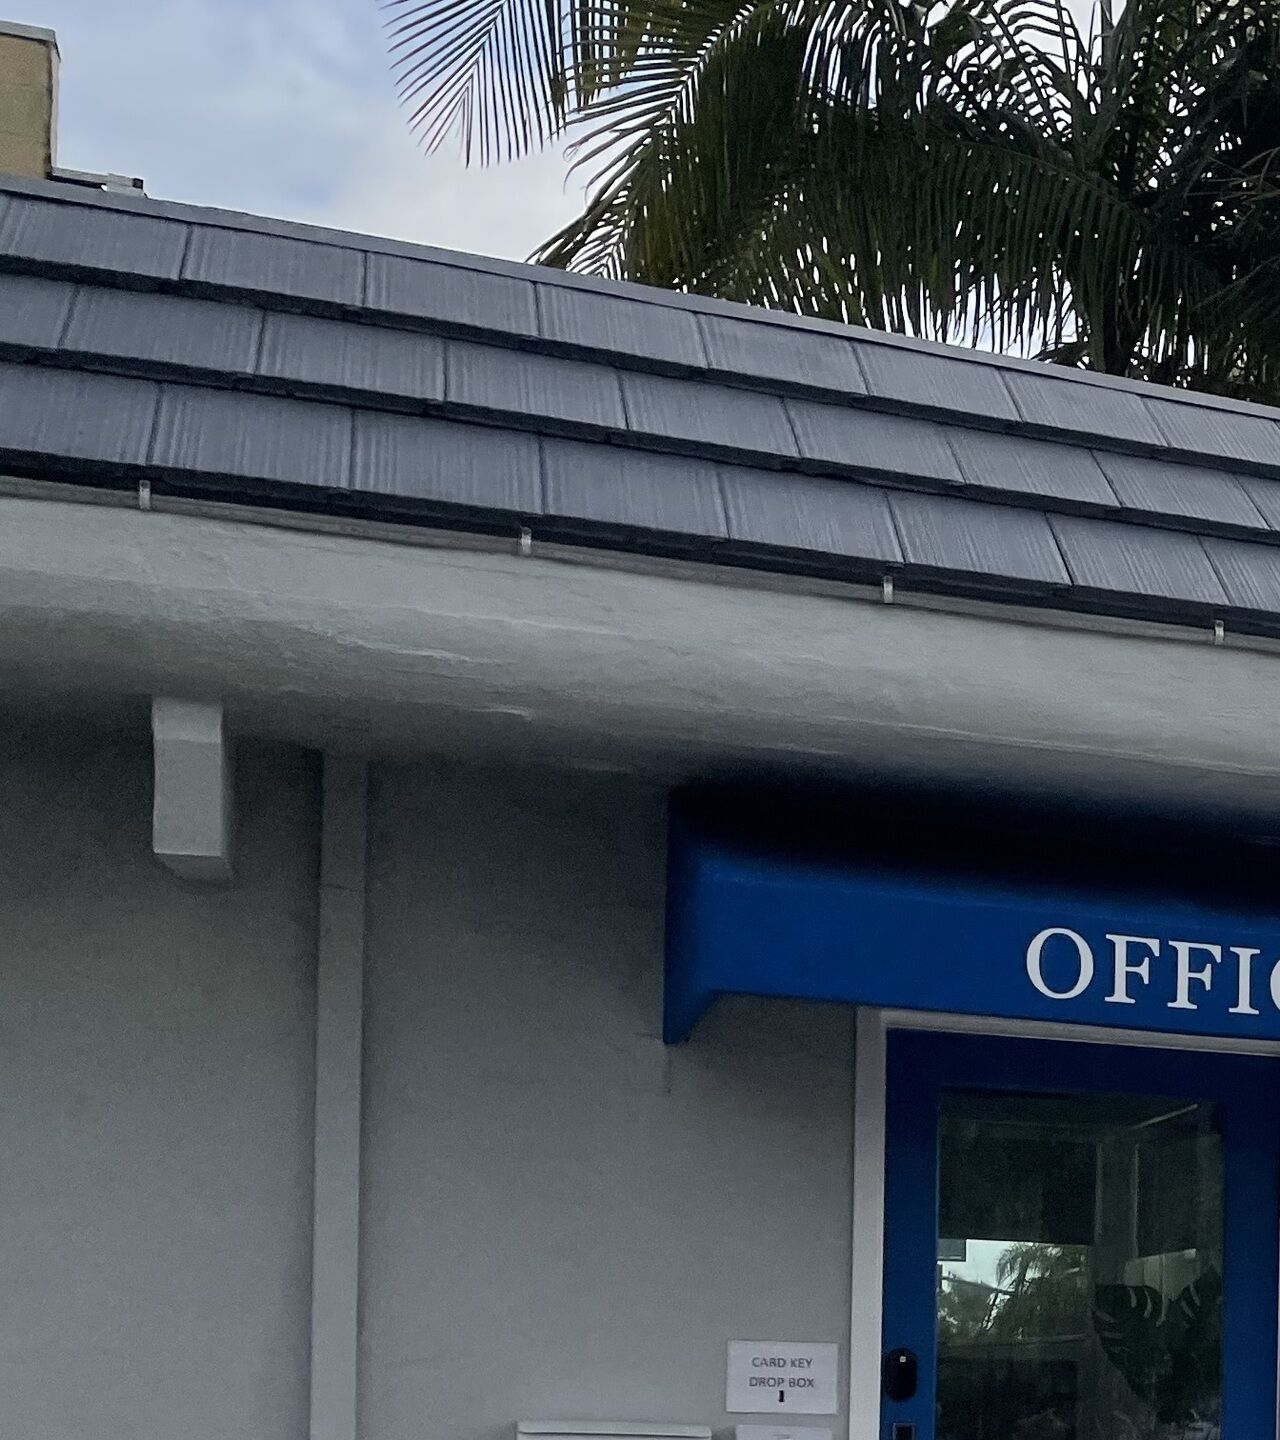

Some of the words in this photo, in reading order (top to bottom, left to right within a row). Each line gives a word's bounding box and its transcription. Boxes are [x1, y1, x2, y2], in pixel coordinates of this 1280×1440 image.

[752, 1357, 786, 1368] CARD
[790, 1358, 814, 1369] KEY
[749, 1377, 785, 1387] DROP
[788, 1377, 815, 1388] BOX
